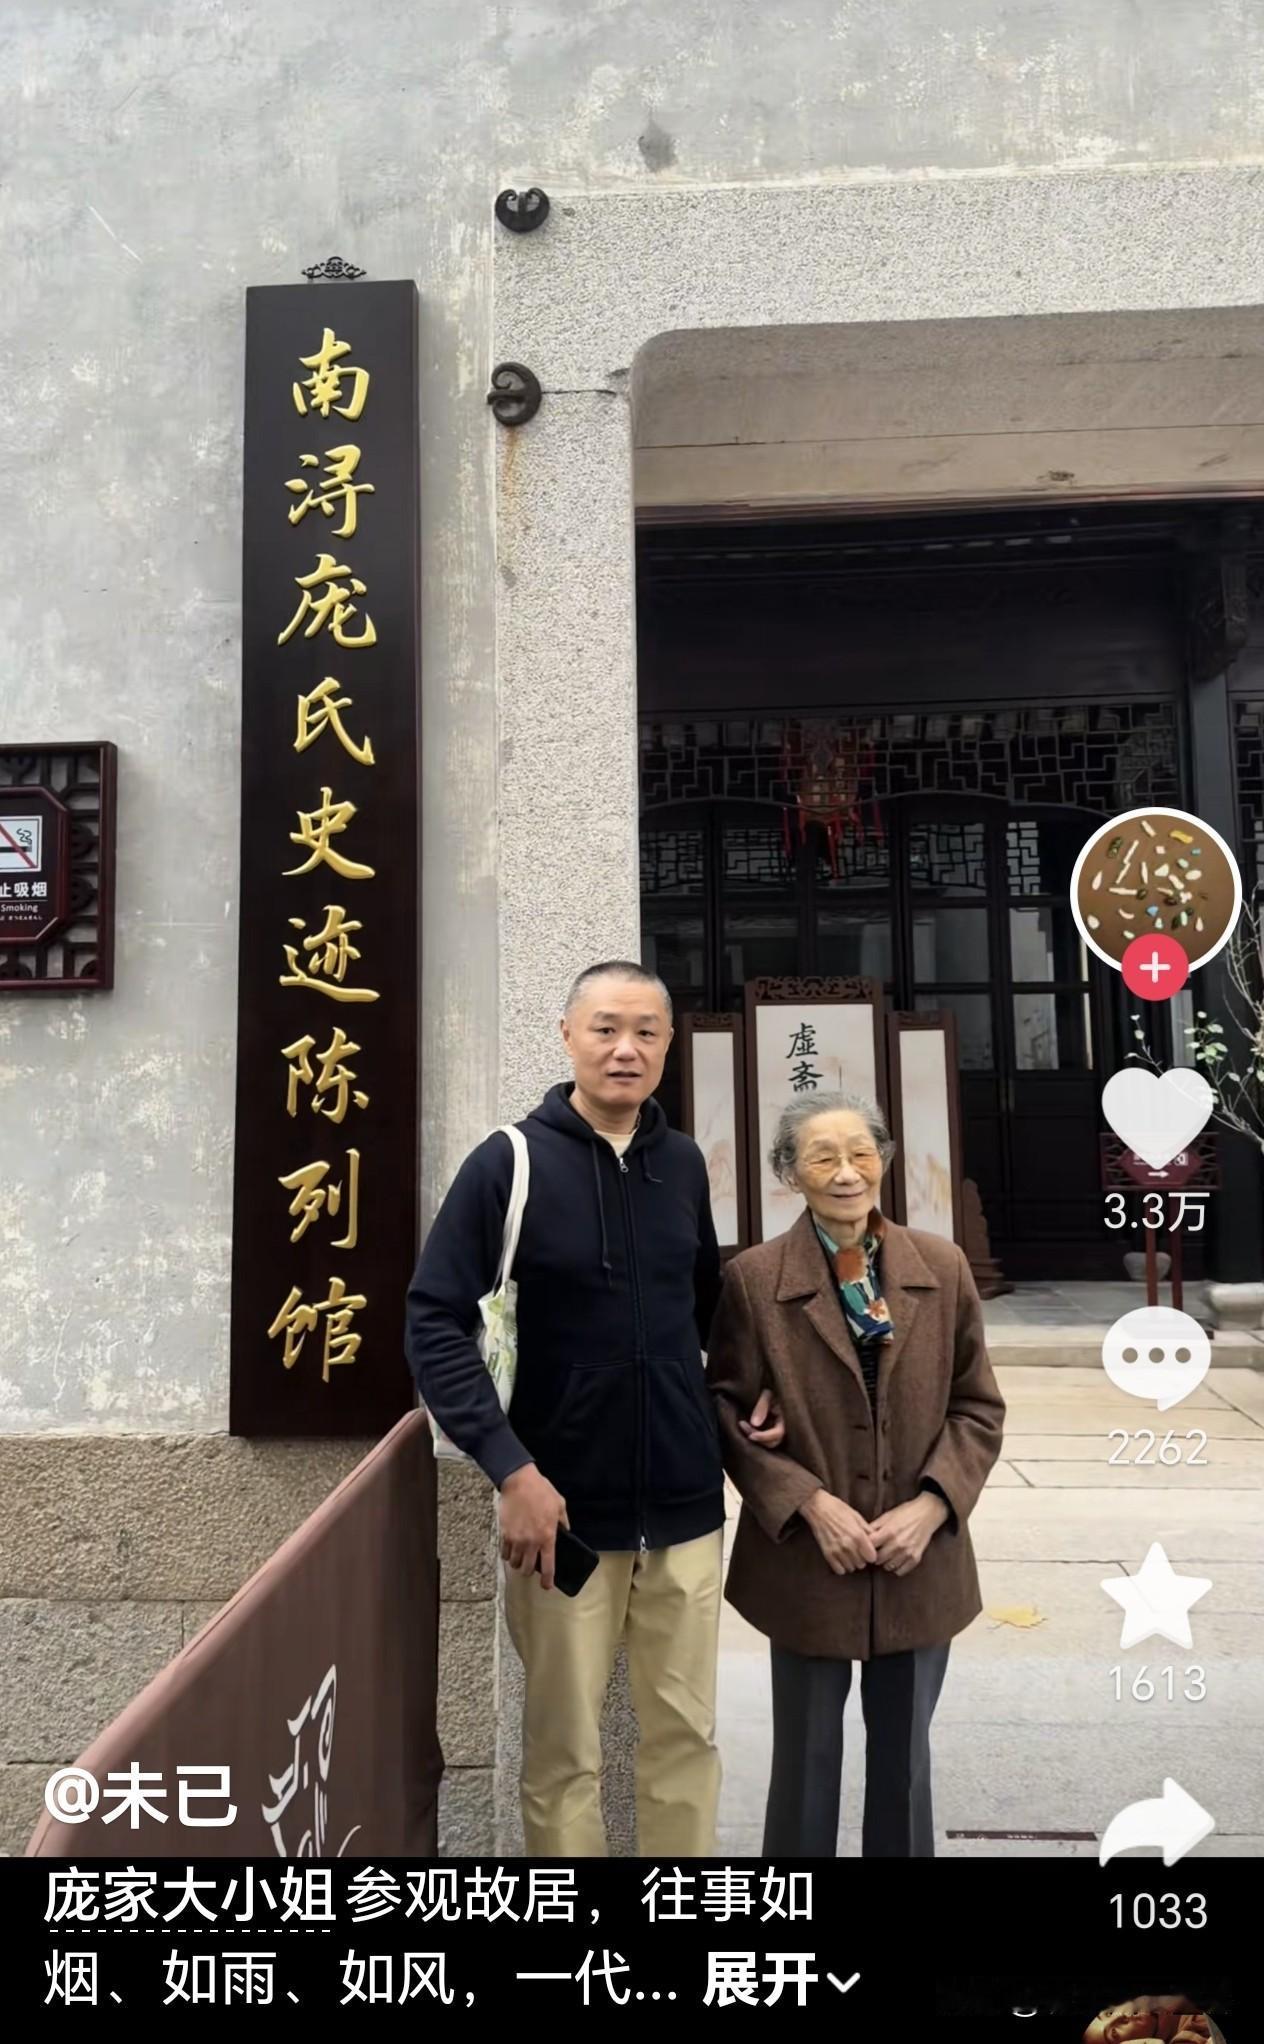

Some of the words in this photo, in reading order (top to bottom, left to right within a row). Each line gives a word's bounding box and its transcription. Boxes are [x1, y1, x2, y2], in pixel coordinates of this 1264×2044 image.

[1, 903, 39, 913] Smoking
[267, 327, 380, 1383] 南浔庞氏史迹陈列馆
